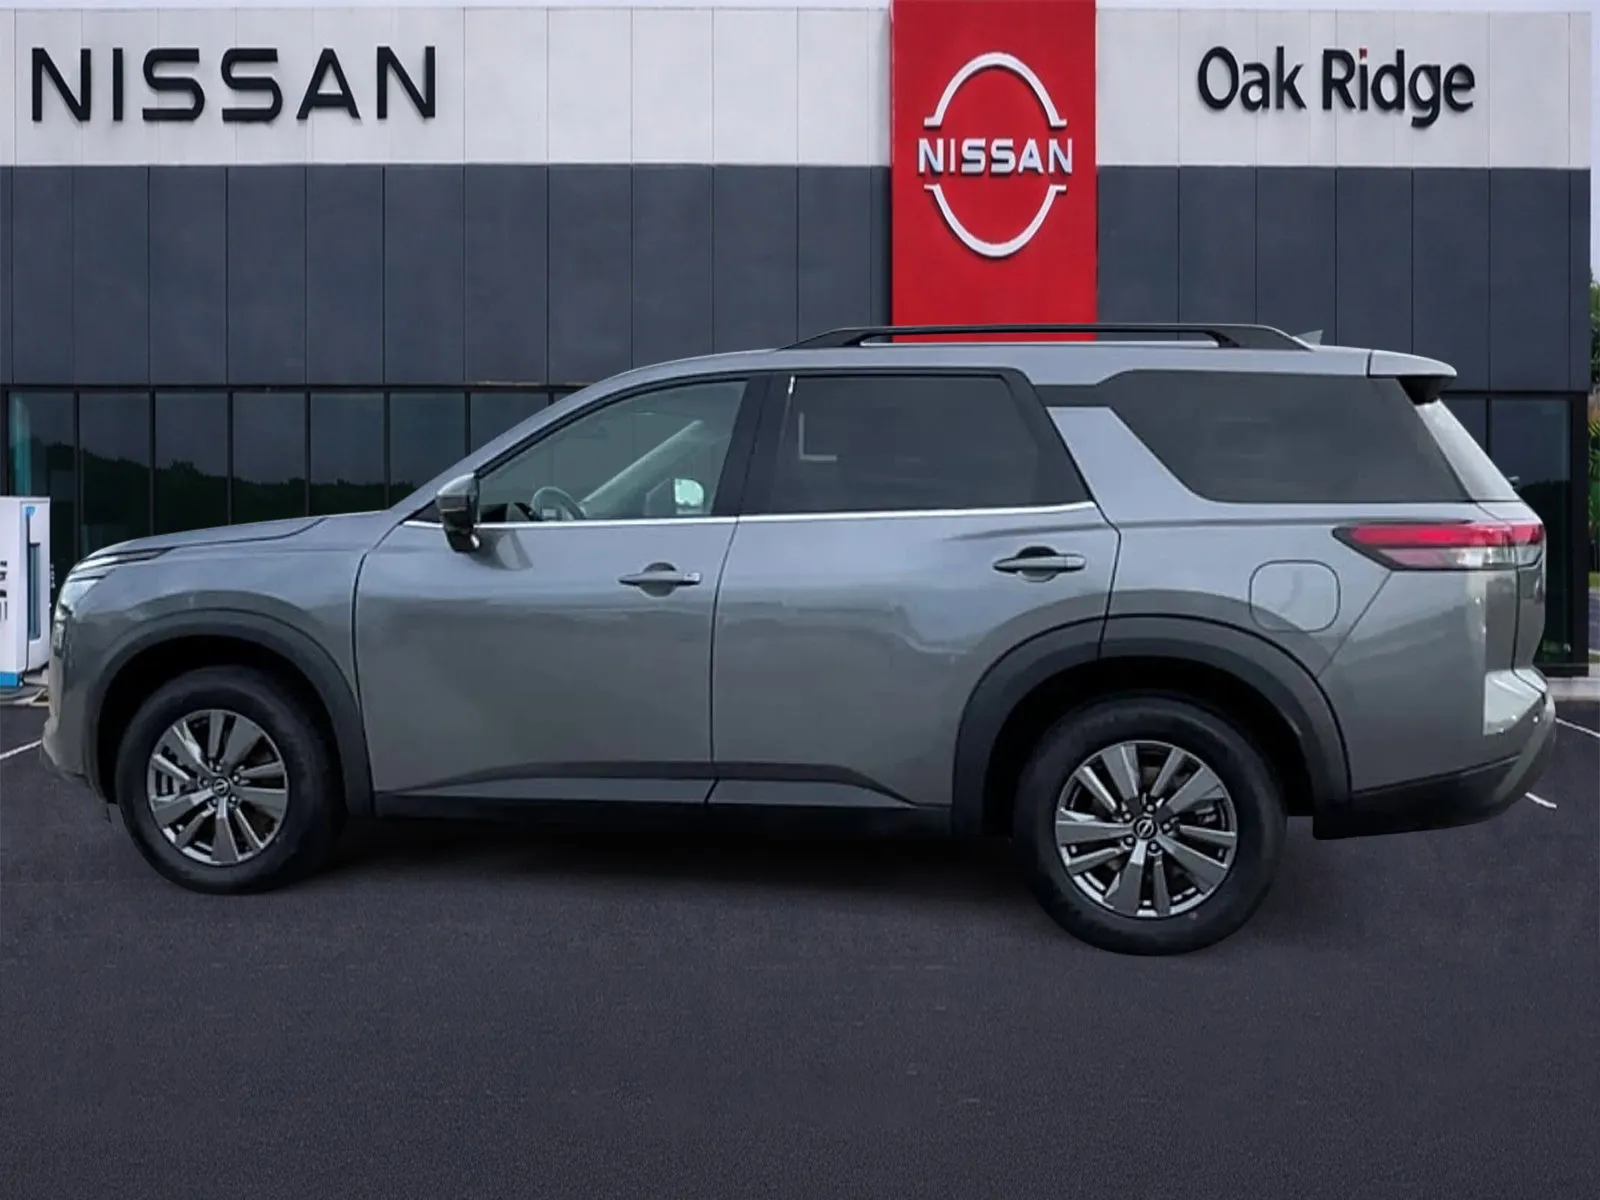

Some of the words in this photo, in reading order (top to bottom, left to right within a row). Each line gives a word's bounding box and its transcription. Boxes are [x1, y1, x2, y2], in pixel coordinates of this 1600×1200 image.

[32, 45, 436, 124] NISSAN
[1198, 46, 1306, 112] Oak
[1322, 48, 1476, 129] Ridge
[917, 138, 1074, 174] NISSAN
